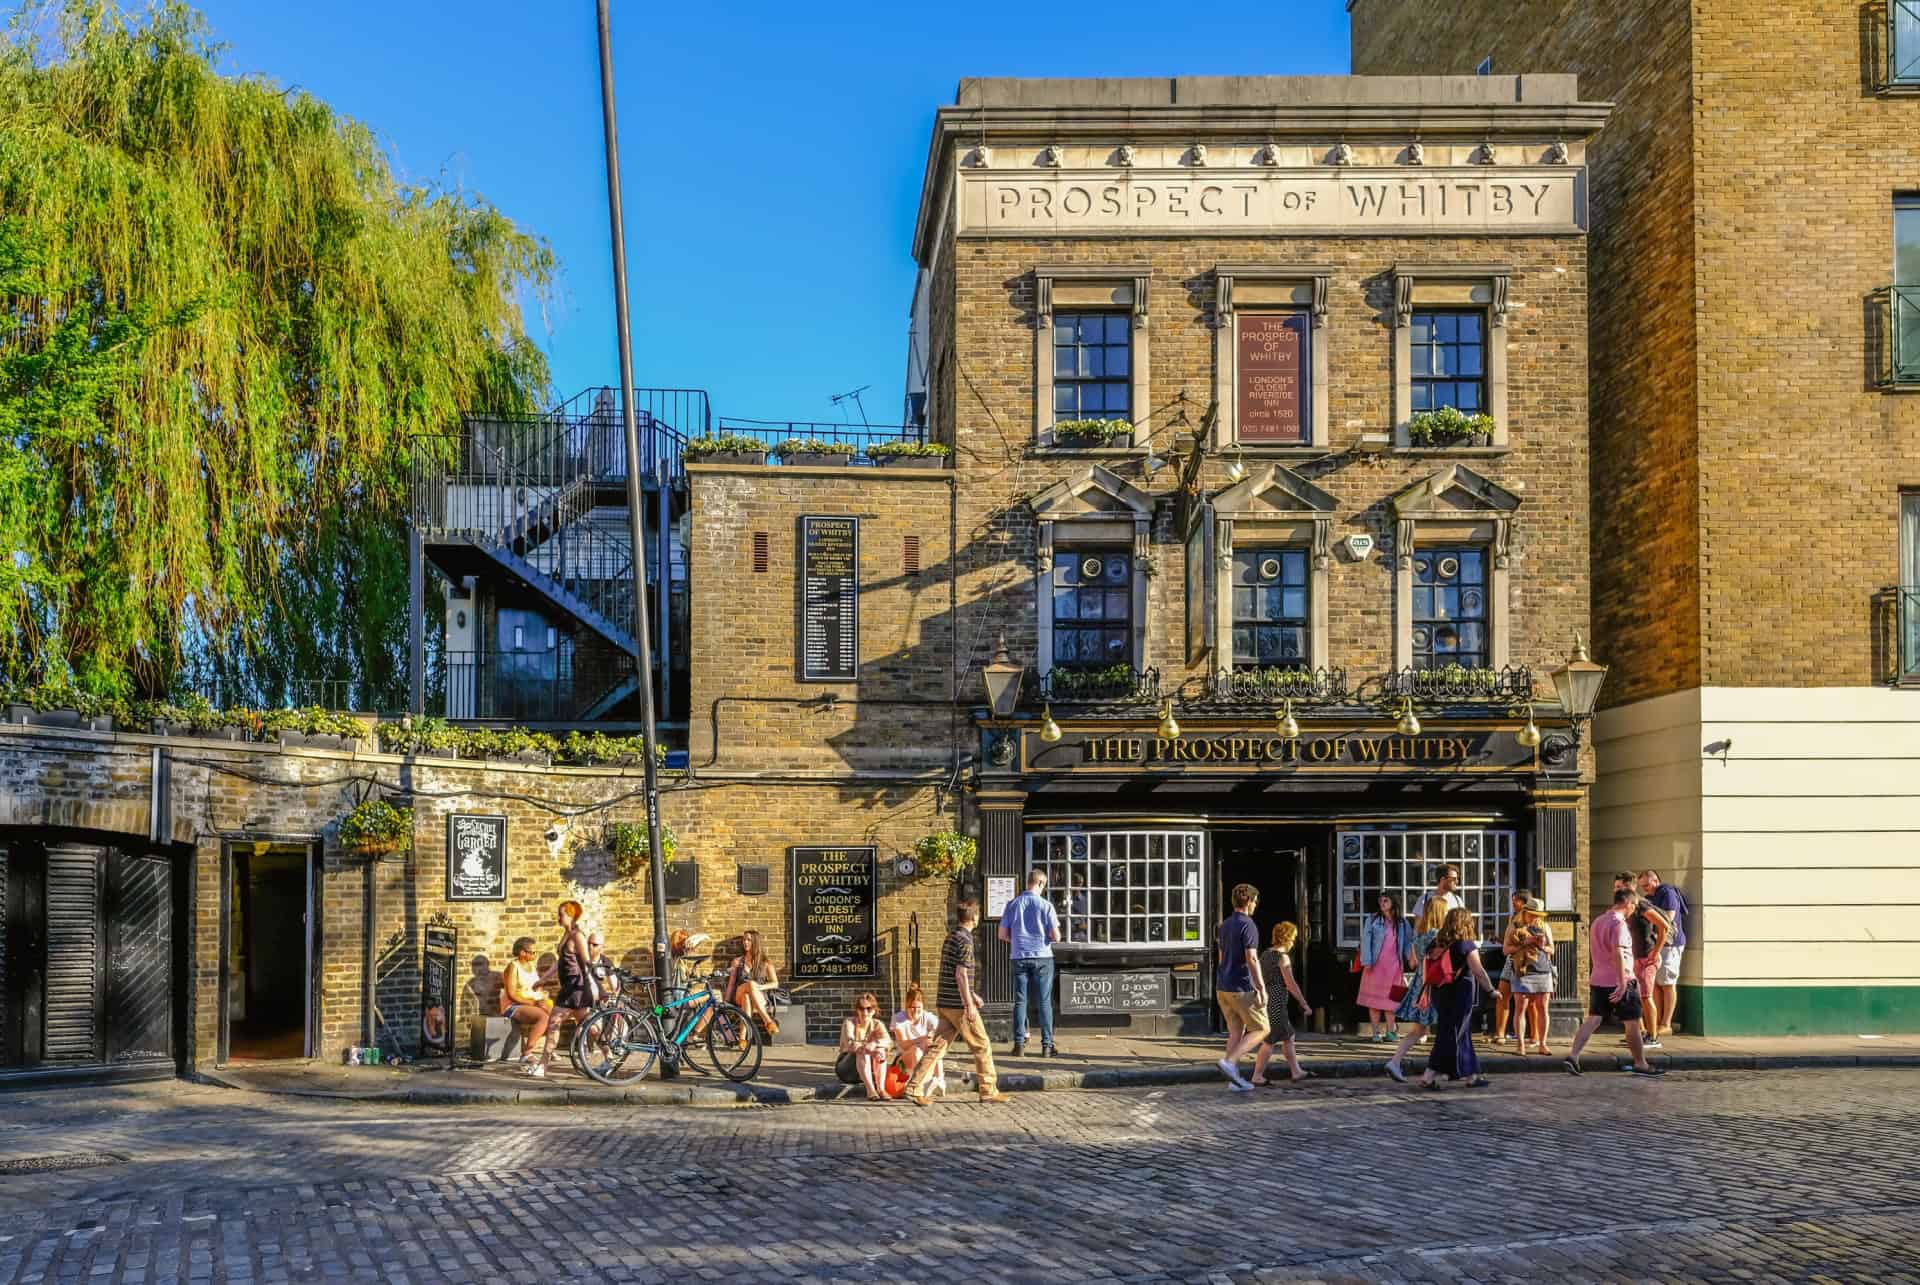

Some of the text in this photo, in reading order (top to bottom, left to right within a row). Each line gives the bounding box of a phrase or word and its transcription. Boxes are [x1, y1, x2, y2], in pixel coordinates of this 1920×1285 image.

[997, 184, 1550, 218] PROSPECT OF WHITBY
[1262, 321, 1284, 331] THE
[1242, 332, 1298, 341] PROSPECT
[1263, 342, 1279, 351] OF
[1250, 352, 1292, 361] WHITBY
[1254, 384, 1287, 392] OLDEST
[1249, 392, 1294, 400] RIVERSIDE
[1085, 737, 1473, 760] THE PROSPECT OF WHITBY
[823, 851, 847, 861] THE
[801, 863, 867, 873] PROSPECT
[798, 875, 870, 886] OF WHITBY
[808, 896, 860, 904] LONDON'S
[814, 905, 855, 914] OLDEST
[808, 915, 862, 923] RIVERSIDE
[825, 925, 843, 933] INN
[802, 943, 866, 954] Circa 1520
[801, 964, 818, 973] 020
[1073, 981, 1112, 993] FOOD
[1071, 996, 1112, 1005] ALL DAY
